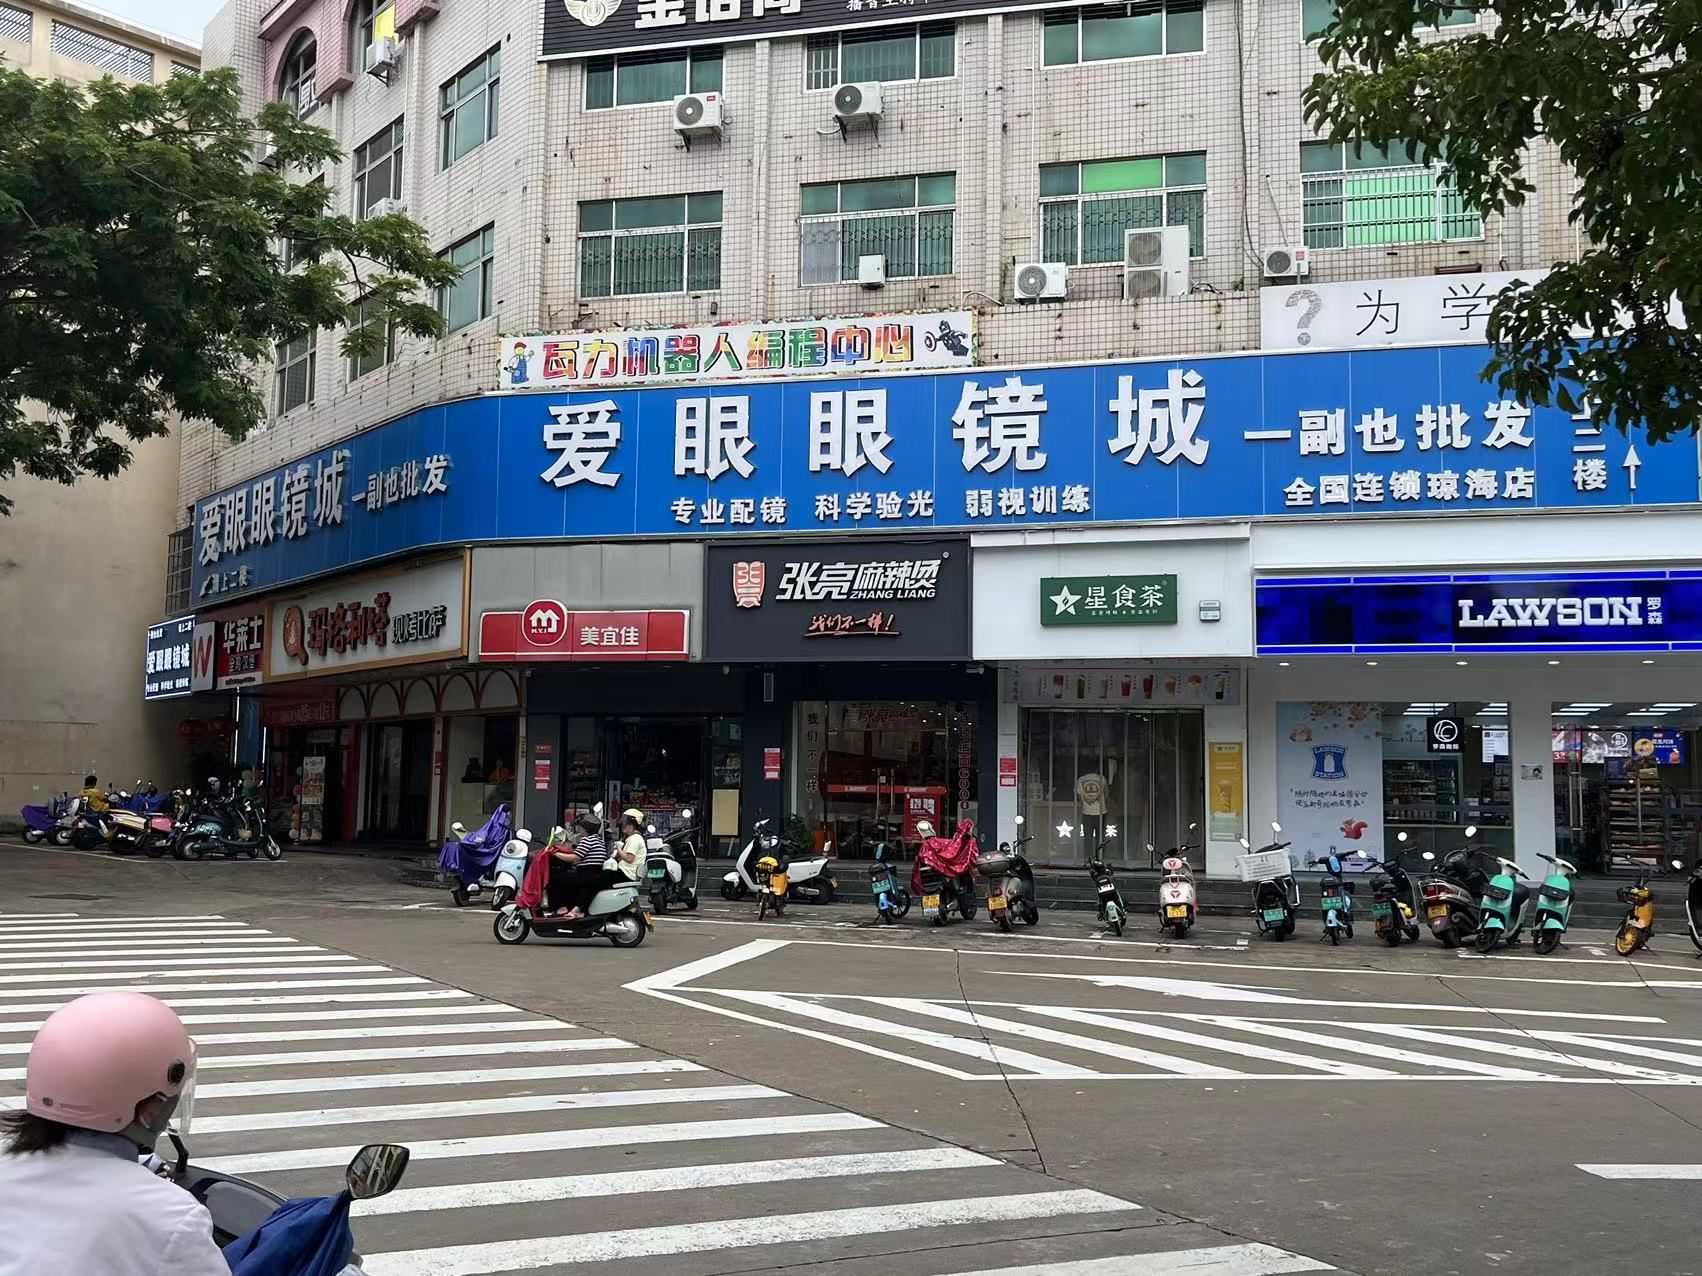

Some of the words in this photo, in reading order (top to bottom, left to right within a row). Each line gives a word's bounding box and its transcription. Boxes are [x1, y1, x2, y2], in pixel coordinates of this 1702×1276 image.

[541, 323, 914, 379] 瓦力机器人编程中心
[540, 369, 1210, 488] 爱眼眼镜城
[1243, 400, 1535, 456] 一副也批发
[1571, 366, 1607, 490] 上二楼
[670, 495, 788, 525] 专业配镜
[814, 489, 935, 522] 科学验光
[965, 486, 1091, 517] 弱视训练
[1283, 467, 1536, 507] 全国连锁琼海店
[199, 449, 350, 567] 爱眼眼镜城
[351, 454, 451, 511] 一副也批发
[775, 559, 942, 600] 张亮麻辣烫
[850, 589, 894, 599] ZHANG
[896, 589, 937, 599] LIANG
[1084, 584, 1164, 609] 星食茶
[1458, 597, 1643, 627] LAWSON
[1647, 597, 1664, 625] 罗森
[223, 616, 262, 654] 华莱士
[580, 626, 639, 646] 美宜佳
